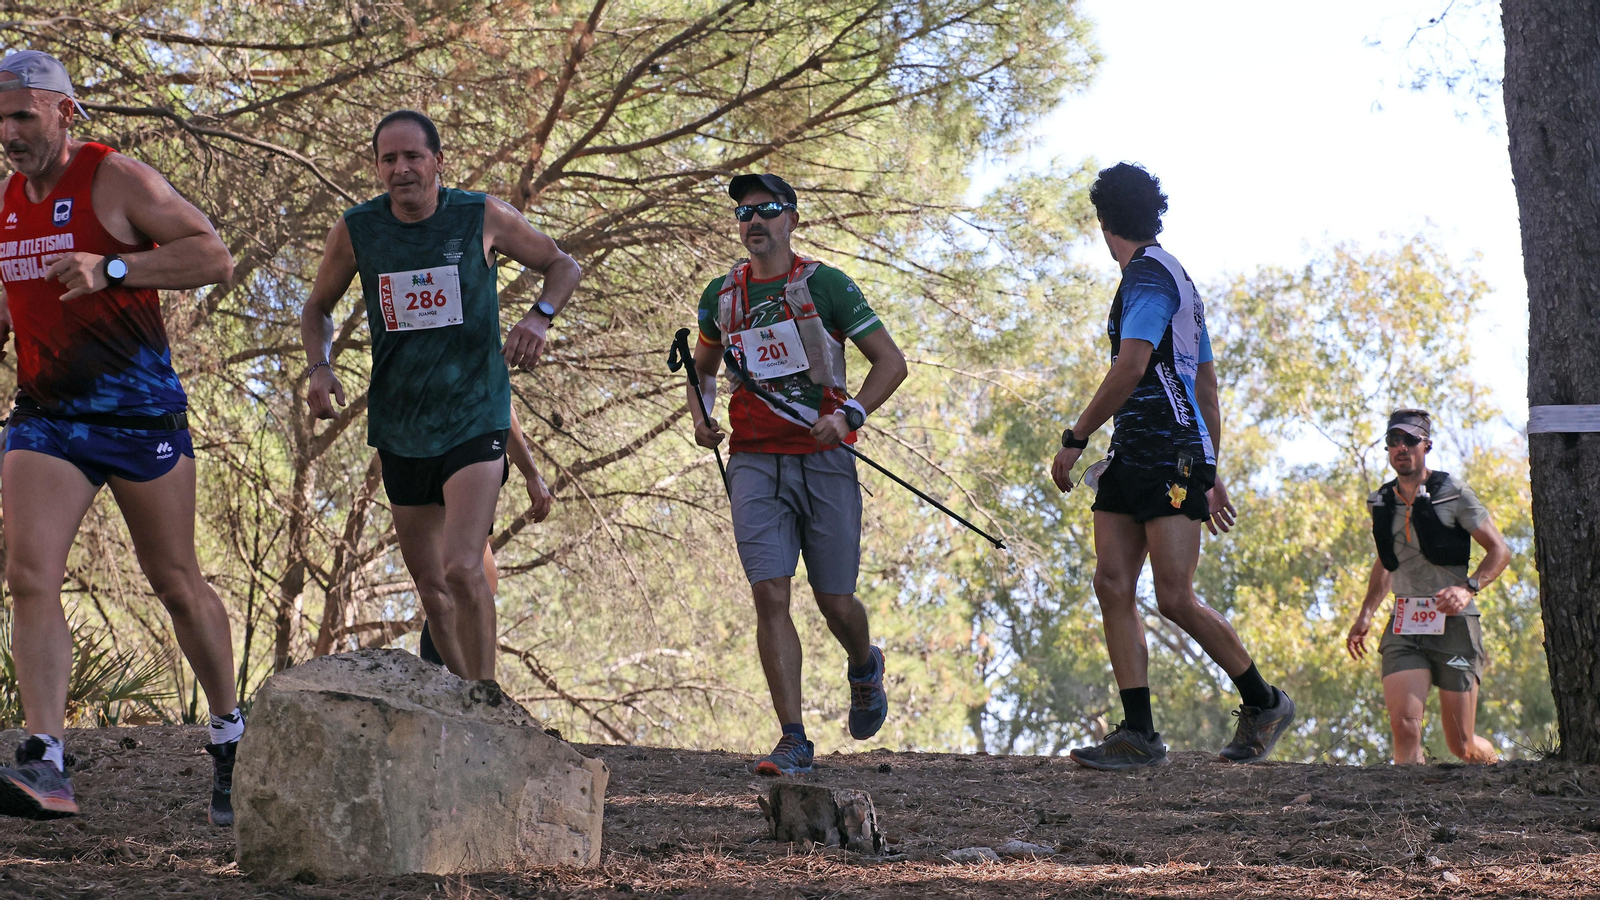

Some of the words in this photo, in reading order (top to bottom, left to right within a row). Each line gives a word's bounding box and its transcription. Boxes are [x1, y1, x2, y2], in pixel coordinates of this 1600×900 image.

[18, 233, 74, 256] ATLETISMO
[0, 253, 59, 282] TREBUJ
[382, 283, 396, 323] PIRATA
[405, 289, 447, 311] 286
[756, 341, 789, 362] 201
[1411, 611, 1437, 623] 499
